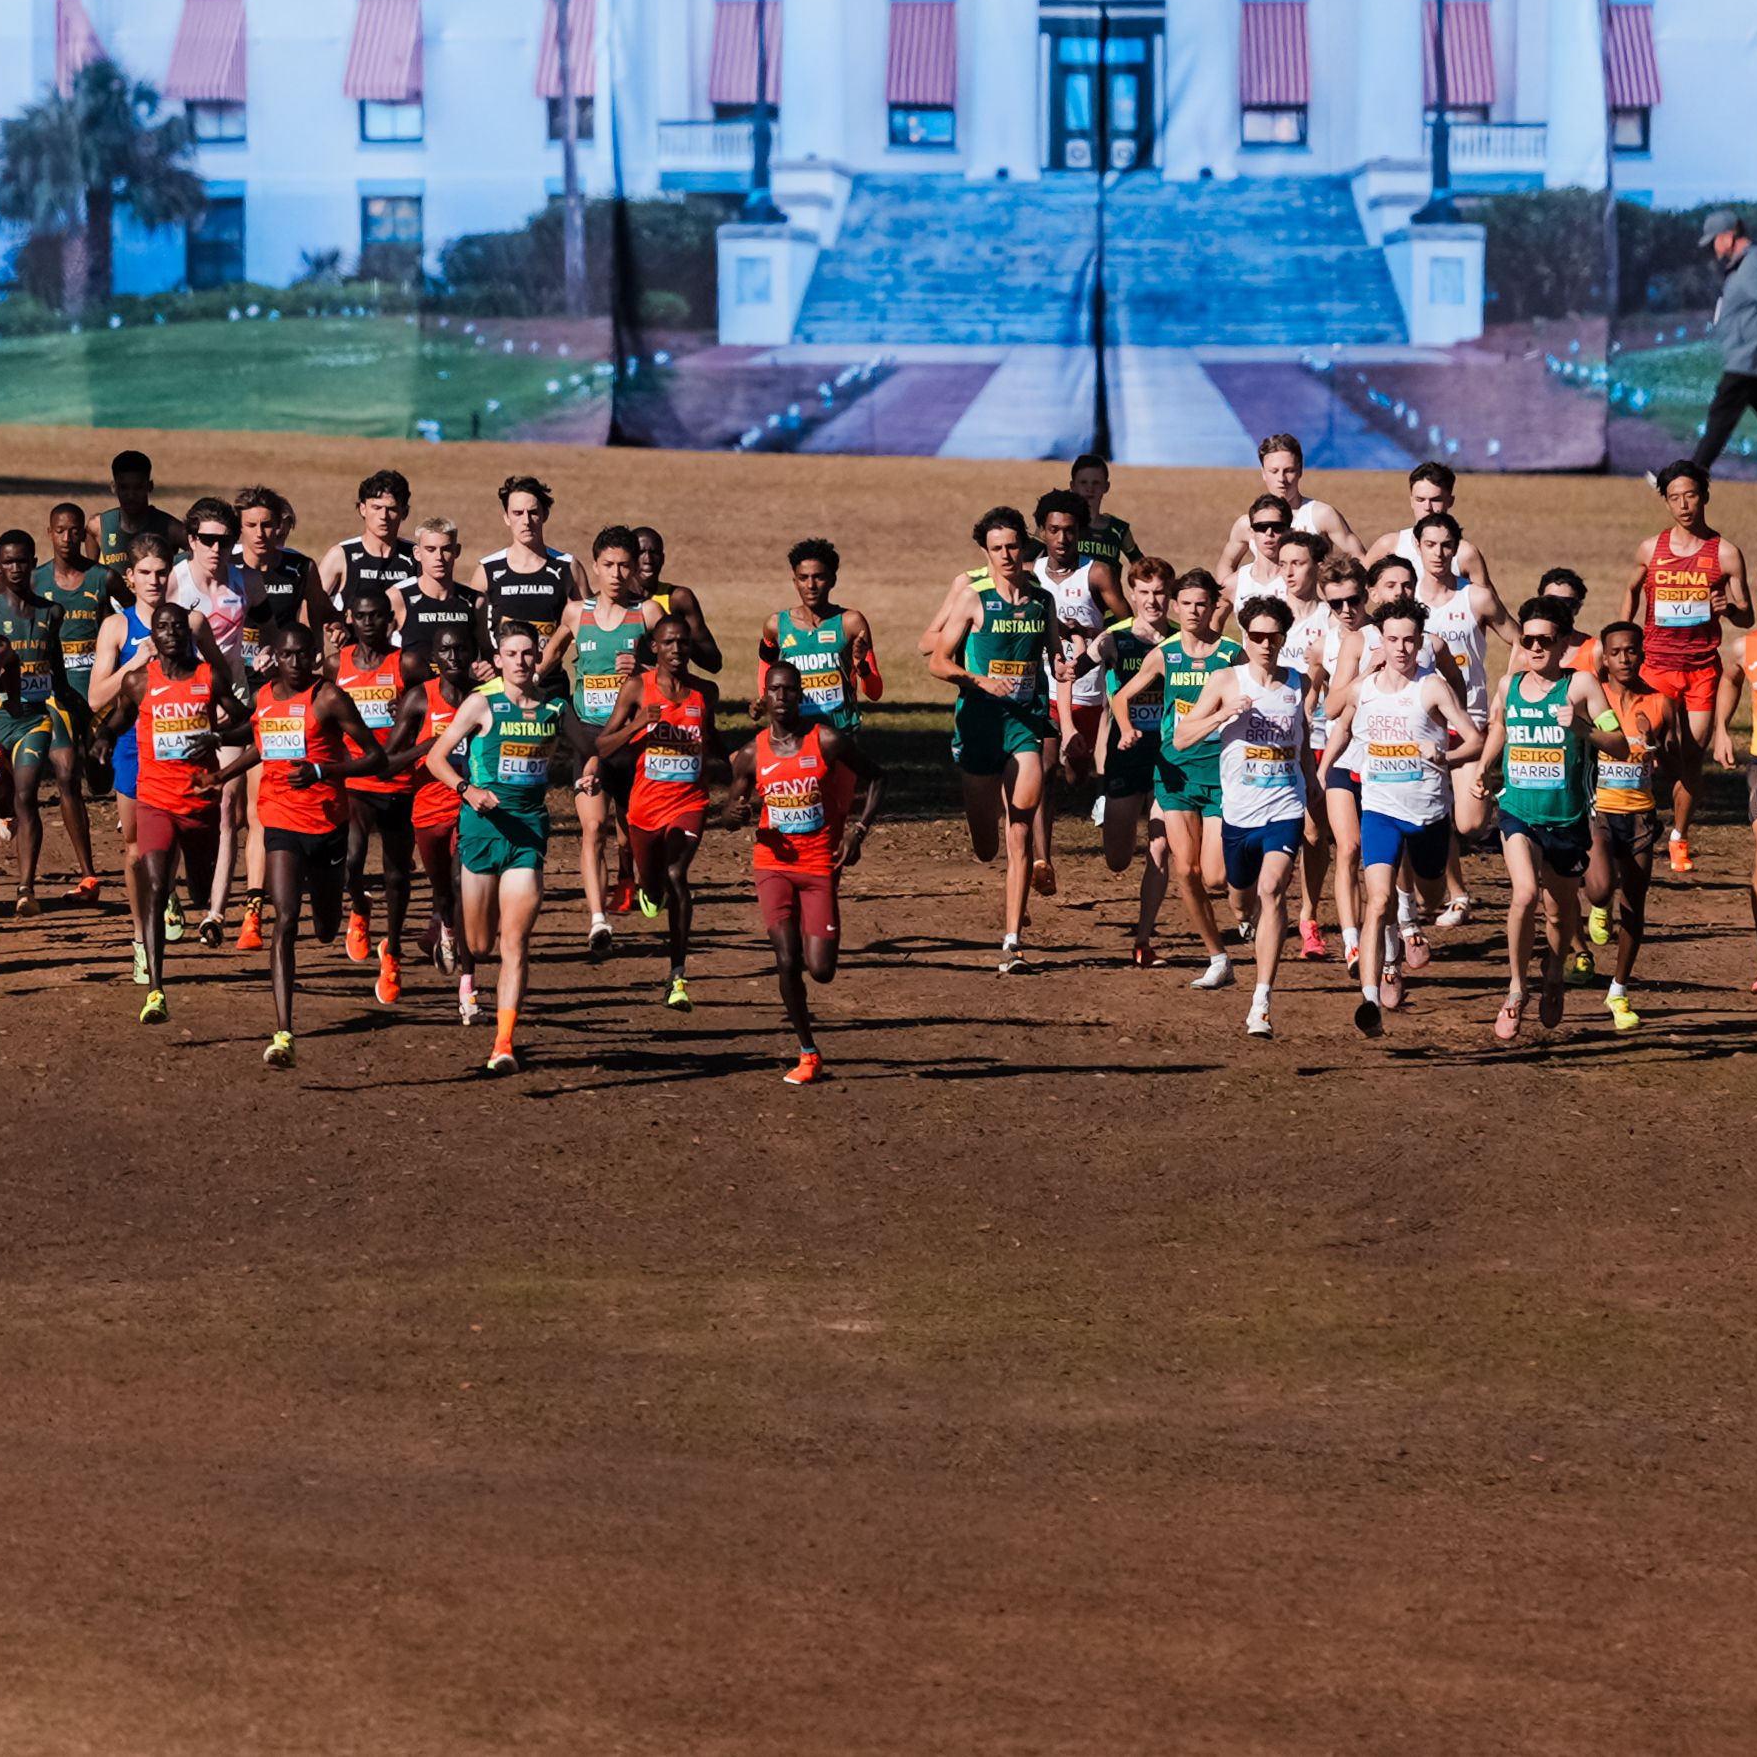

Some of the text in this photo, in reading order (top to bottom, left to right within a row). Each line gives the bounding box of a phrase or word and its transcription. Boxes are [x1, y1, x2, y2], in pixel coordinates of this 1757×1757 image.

[1077, 540, 1118, 558] USTRALI
[360, 569, 378, 580] NEW
[1654, 569, 1709, 587] CHINA
[500, 584, 554, 596] NEW ZEALAND
[1656, 589, 1709, 601] SEIKO
[71, 609, 97, 620] AFRIC
[1671, 603, 1693, 616] YU
[418, 612, 469, 623] NEW ZEALAND
[992, 619, 1046, 633] AUSTRALIA
[785, 652, 841, 672] THIOPIA
[800, 673, 840, 688] EIKO
[1170, 671, 1209, 686] AUSTRA
[350, 687, 395, 701] EIKO
[151, 702, 208, 719] KENYA
[154, 717, 209, 733] SEIKO
[1249, 715, 1296, 730] GREAT
[1367, 714, 1409, 728] GREAT
[499, 720, 556, 737] AUSTRALIA
[646, 722, 702, 742] KENYA
[1245, 729, 1296, 742] BRITAIN
[647, 742, 700, 756] SEIKO
[1245, 746, 1295, 761] SEIKO
[1368, 743, 1420, 757] SEIKO
[1510, 750, 1562, 763] SEIKO
[648, 757, 700, 772] KIPTOO
[1261, 763, 1296, 777] CLARK
[1368, 757, 1418, 772] LENNON
[1510, 765, 1561, 778] HARRIS
[1597, 764, 1650, 779] BARRIOS
[762, 776, 819, 796] KENYA
[766, 794, 820, 808] SEIKO
[770, 806, 822, 822] ELKANA
